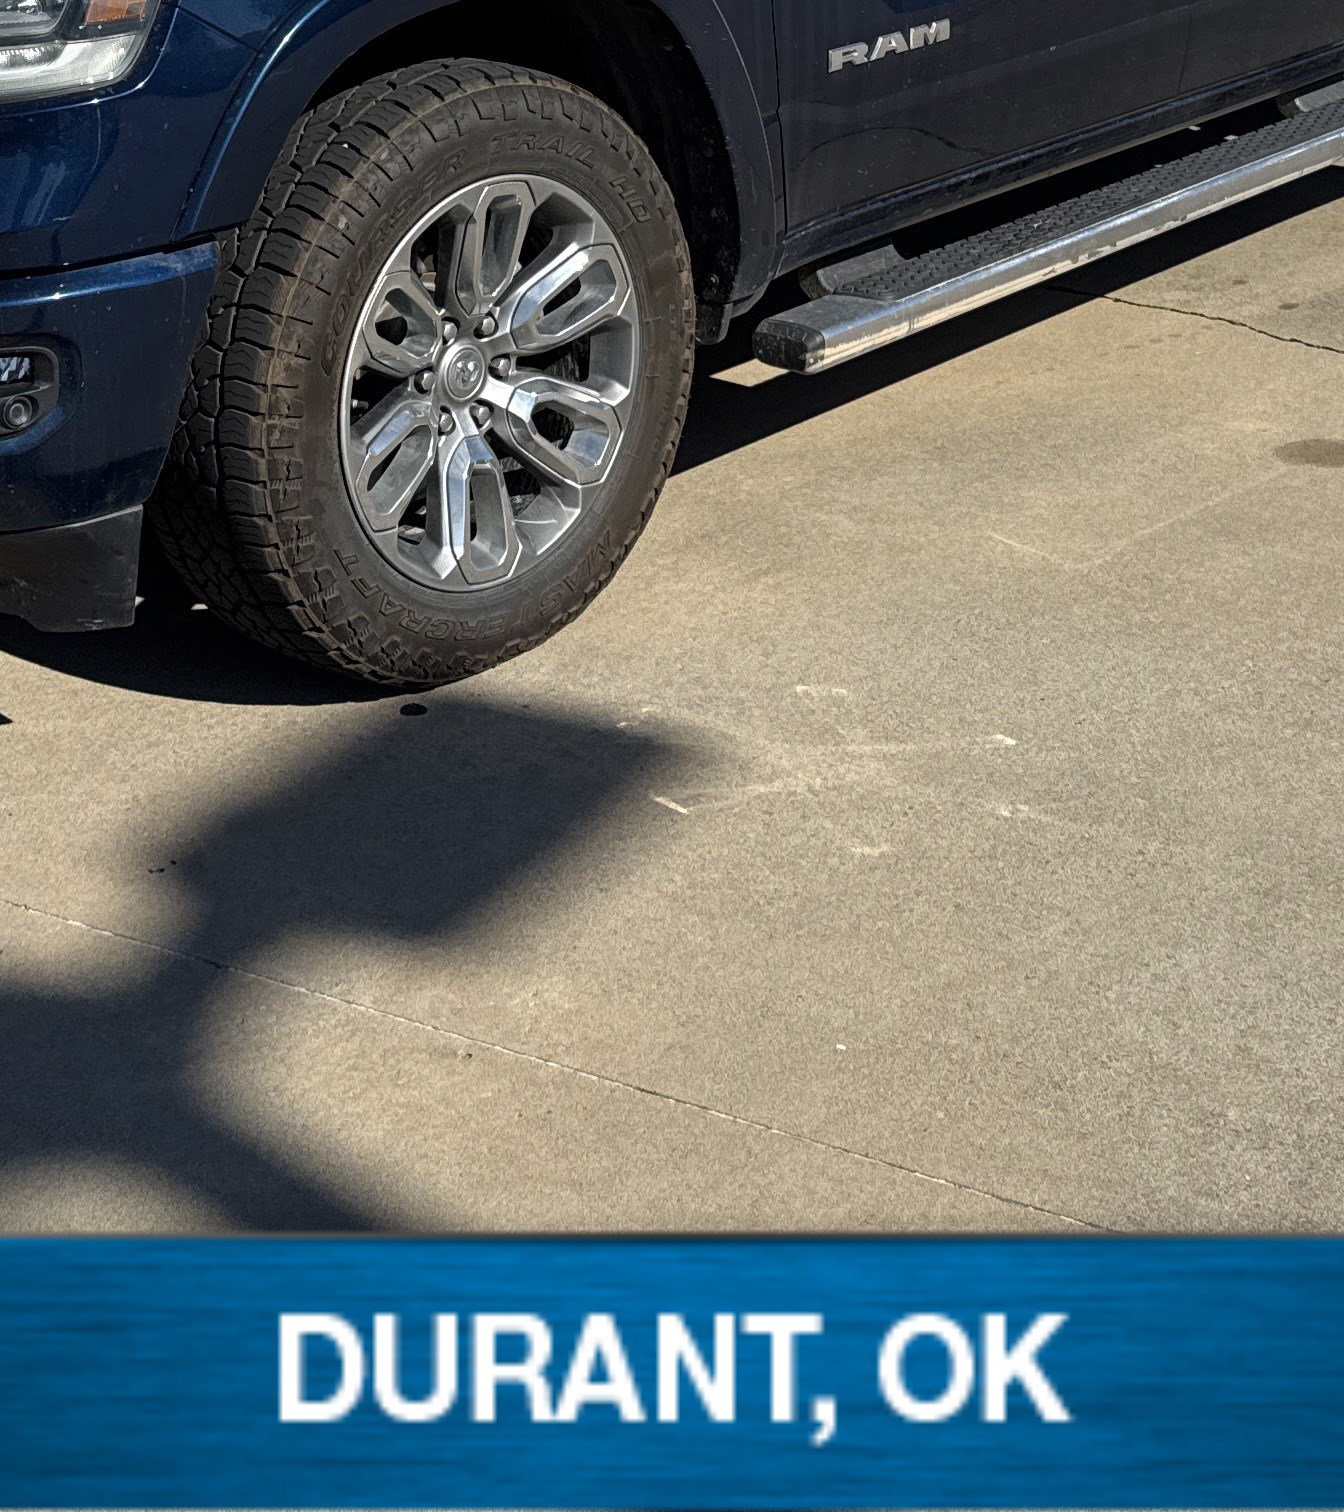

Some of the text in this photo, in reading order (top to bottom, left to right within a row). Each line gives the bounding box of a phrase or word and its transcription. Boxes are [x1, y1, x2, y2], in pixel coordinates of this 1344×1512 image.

[827, 17, 951, 74] RAM
[488, 131, 596, 170] TRAIL
[608, 174, 653, 224] HD
[333, 531, 613, 642] MASTERCRAFT
